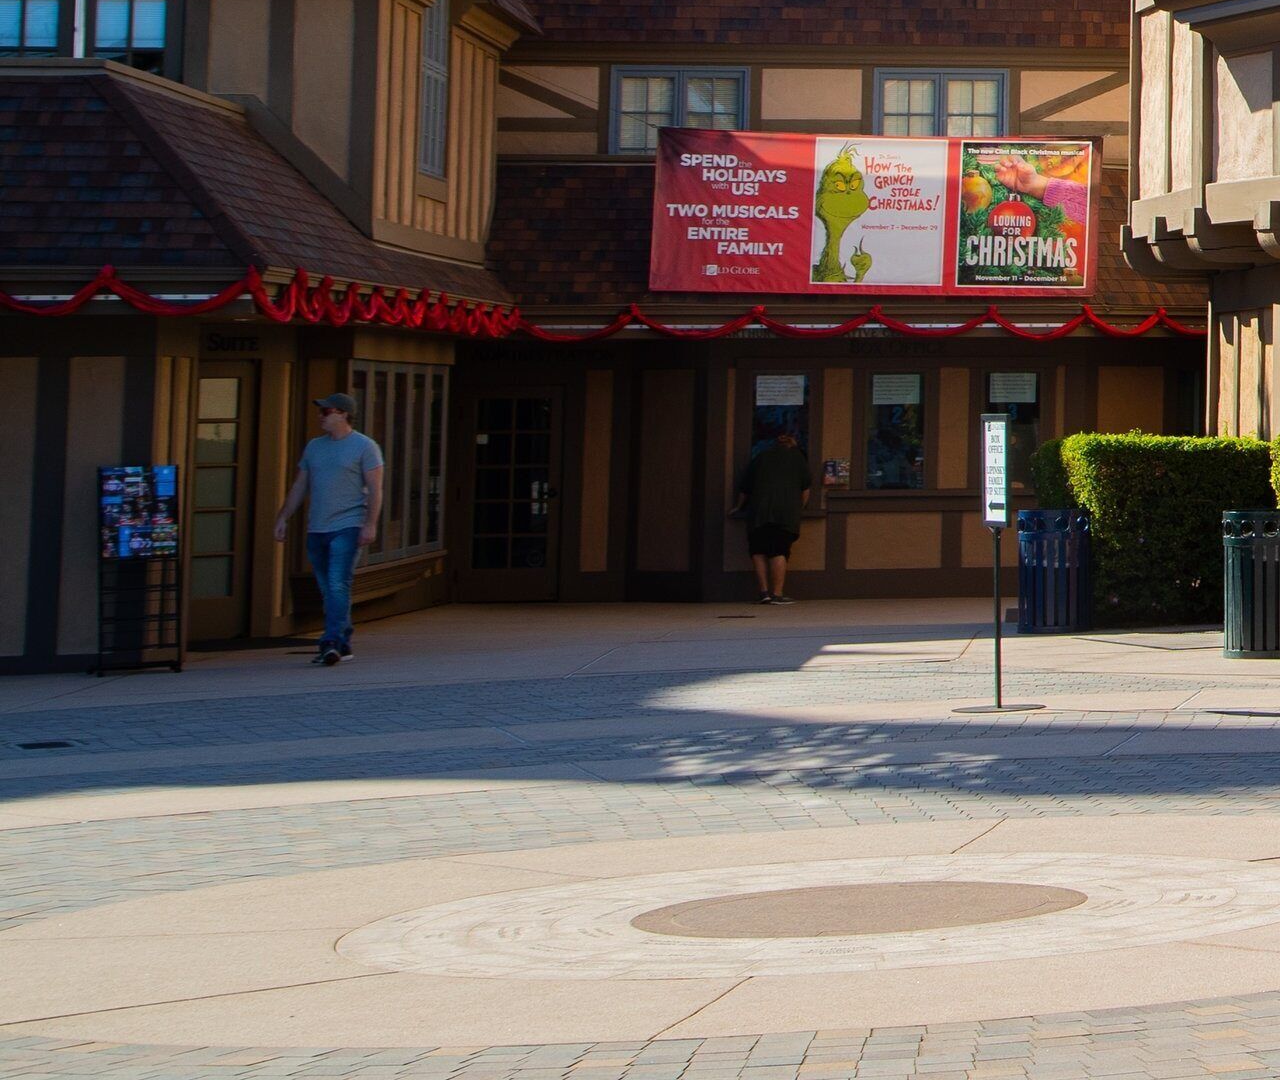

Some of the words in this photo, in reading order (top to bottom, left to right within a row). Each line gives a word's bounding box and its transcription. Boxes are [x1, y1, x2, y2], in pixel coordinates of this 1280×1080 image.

[680, 154, 738, 168] SPEND
[739, 160, 752, 168] the
[864, 156, 892, 176] HOW
[894, 163, 912, 174] The
[702, 169, 787, 183] HOLIDAYS
[874, 174, 914, 189] GRINCH
[731, 183, 760, 196] US!
[890, 188, 921, 198] STOLE
[868, 195, 940, 212] CHRISTMAS!
[666, 204, 709, 217] TWO
[712, 205, 800, 219] MUSICALS
[994, 215, 1032, 226] LOOKING
[688, 227, 749, 240] ENTIRE
[1002, 227, 1021, 236] FOR
[717, 242, 784, 256] FAMILY!
[966, 235, 1078, 268] CHRISTMAS
[730, 266, 760, 274] GLOBE
[207, 333, 260, 352] SUITE
[991, 434, 1000, 443] BOX
[988, 445, 1004, 454] OFFICE
